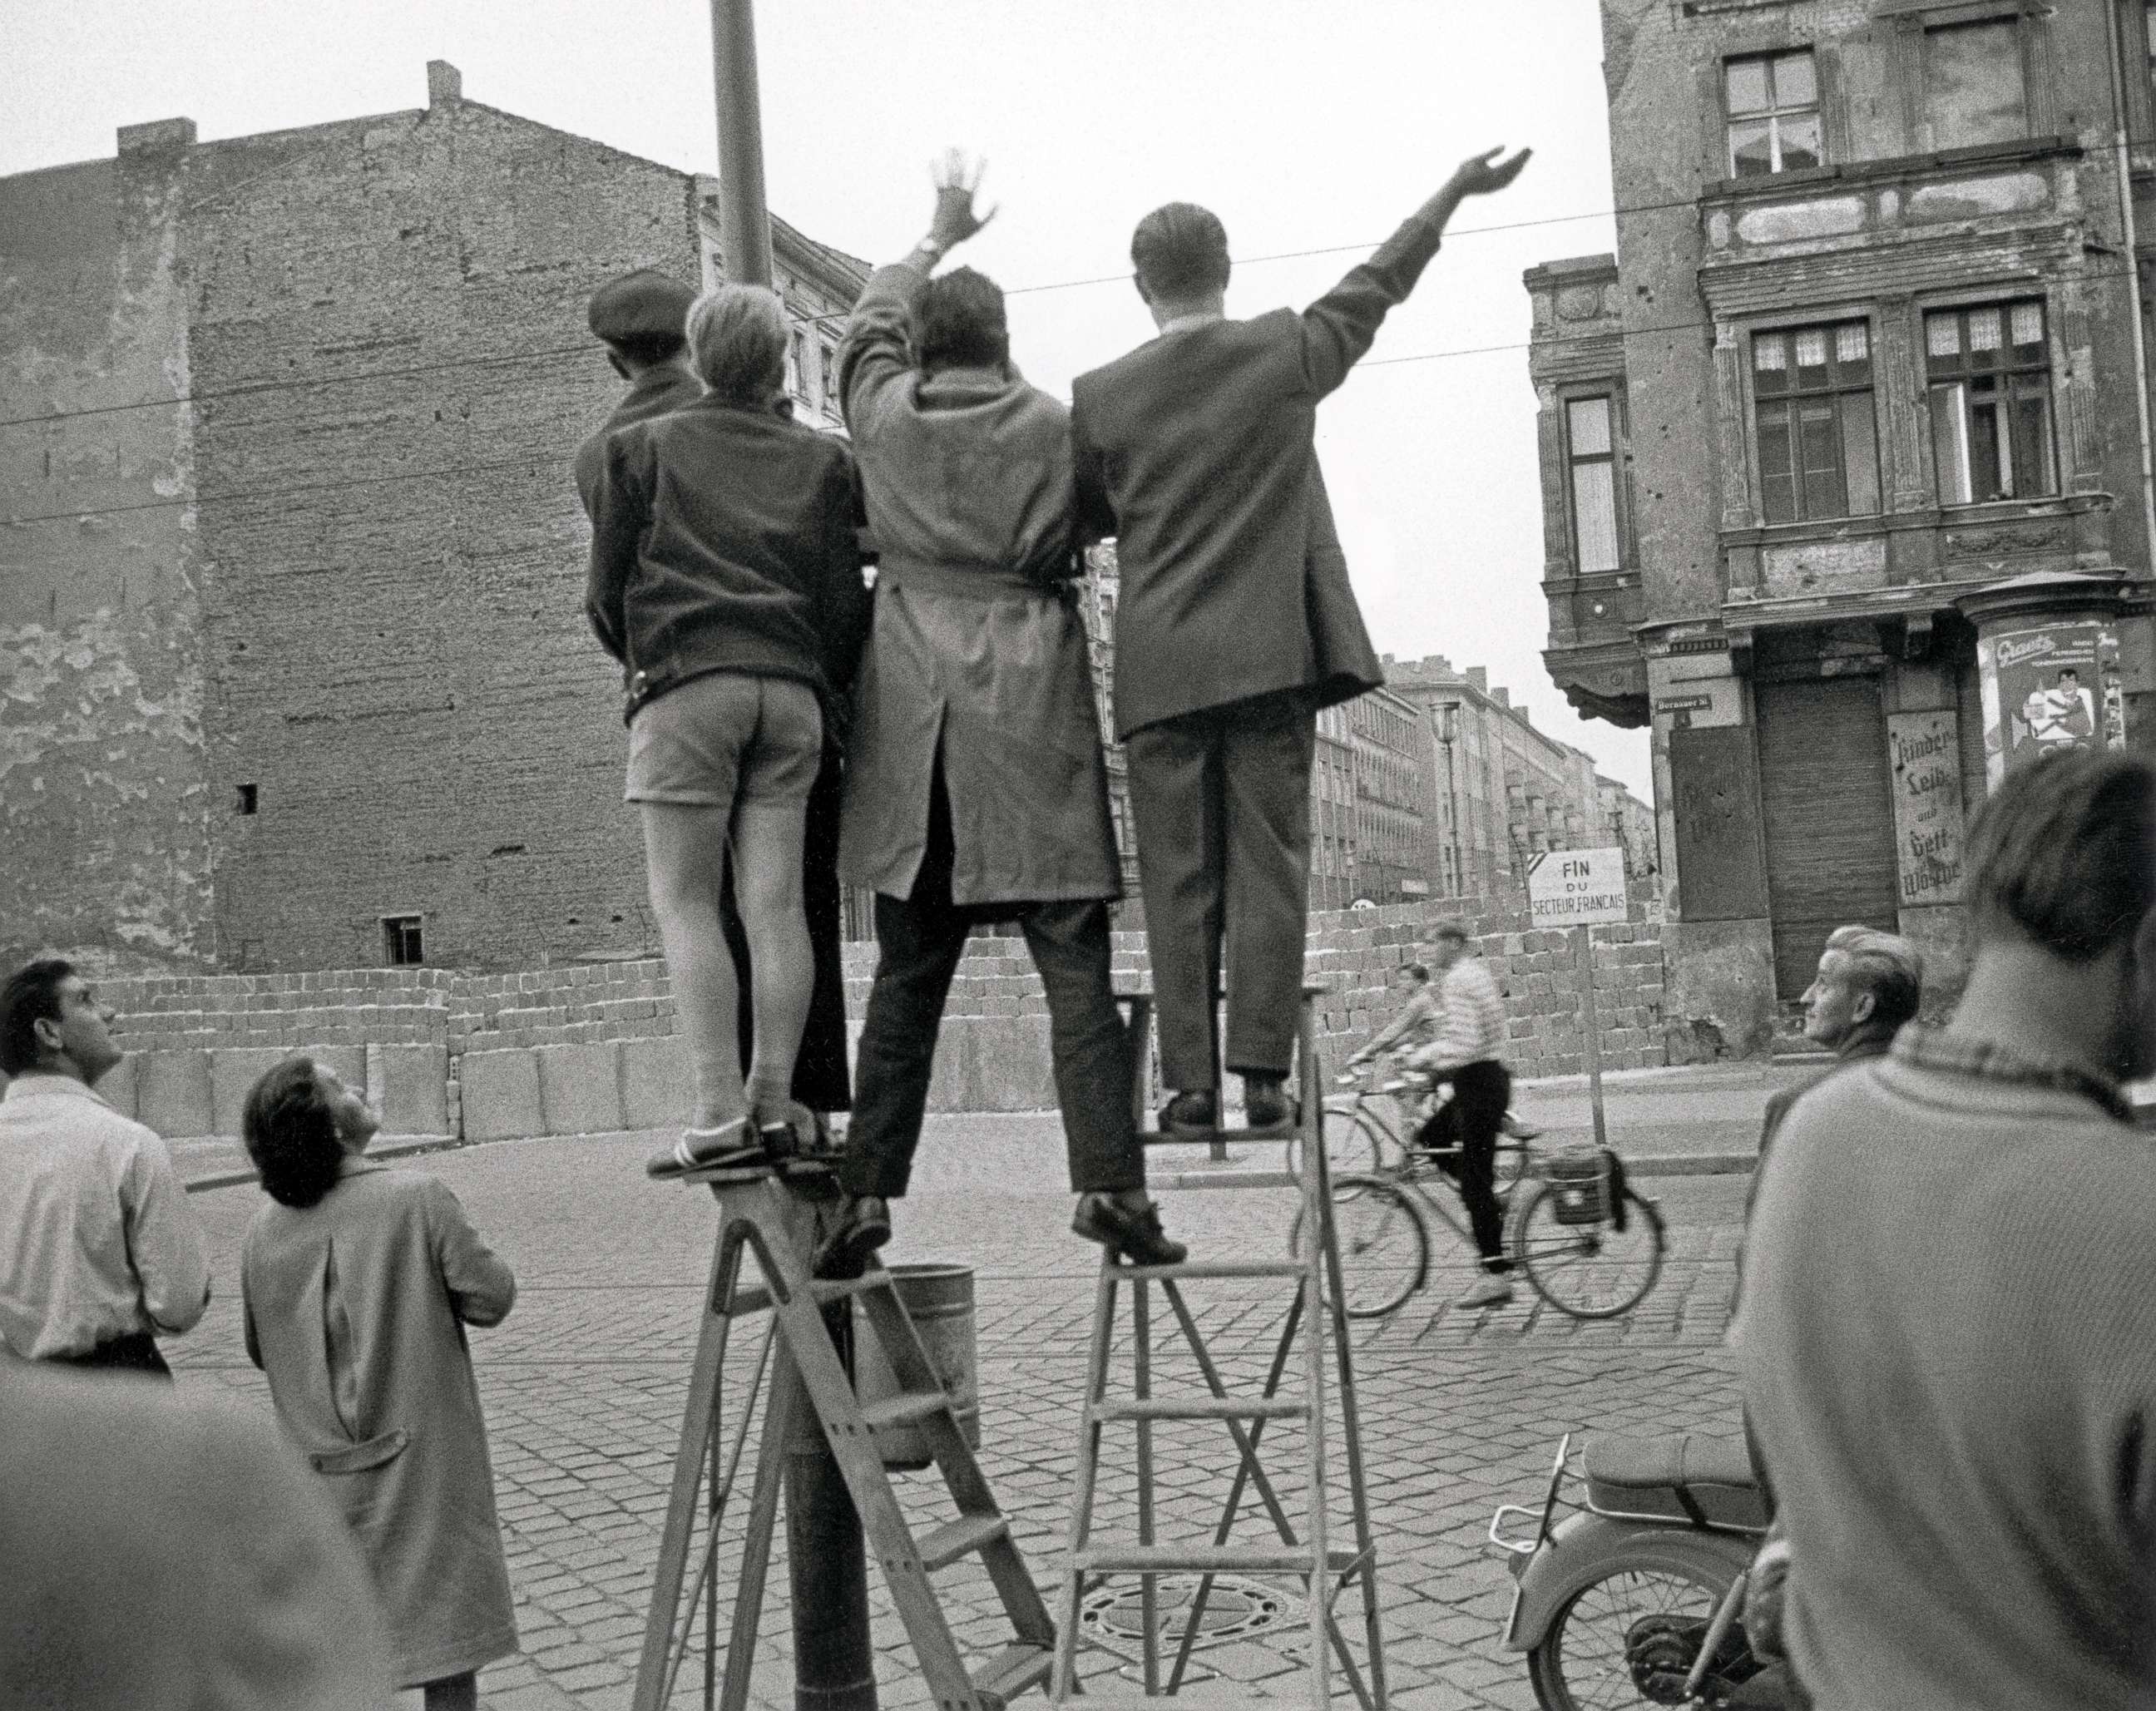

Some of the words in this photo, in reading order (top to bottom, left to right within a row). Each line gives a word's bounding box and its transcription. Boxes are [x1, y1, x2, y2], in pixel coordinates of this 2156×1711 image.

[1562, 860, 1590, 878] FIN
[1566, 882, 1588, 893] DU
[1532, 898, 1575, 916] SECTEUR
[1578, 893, 1625, 912] FRANCAIS
